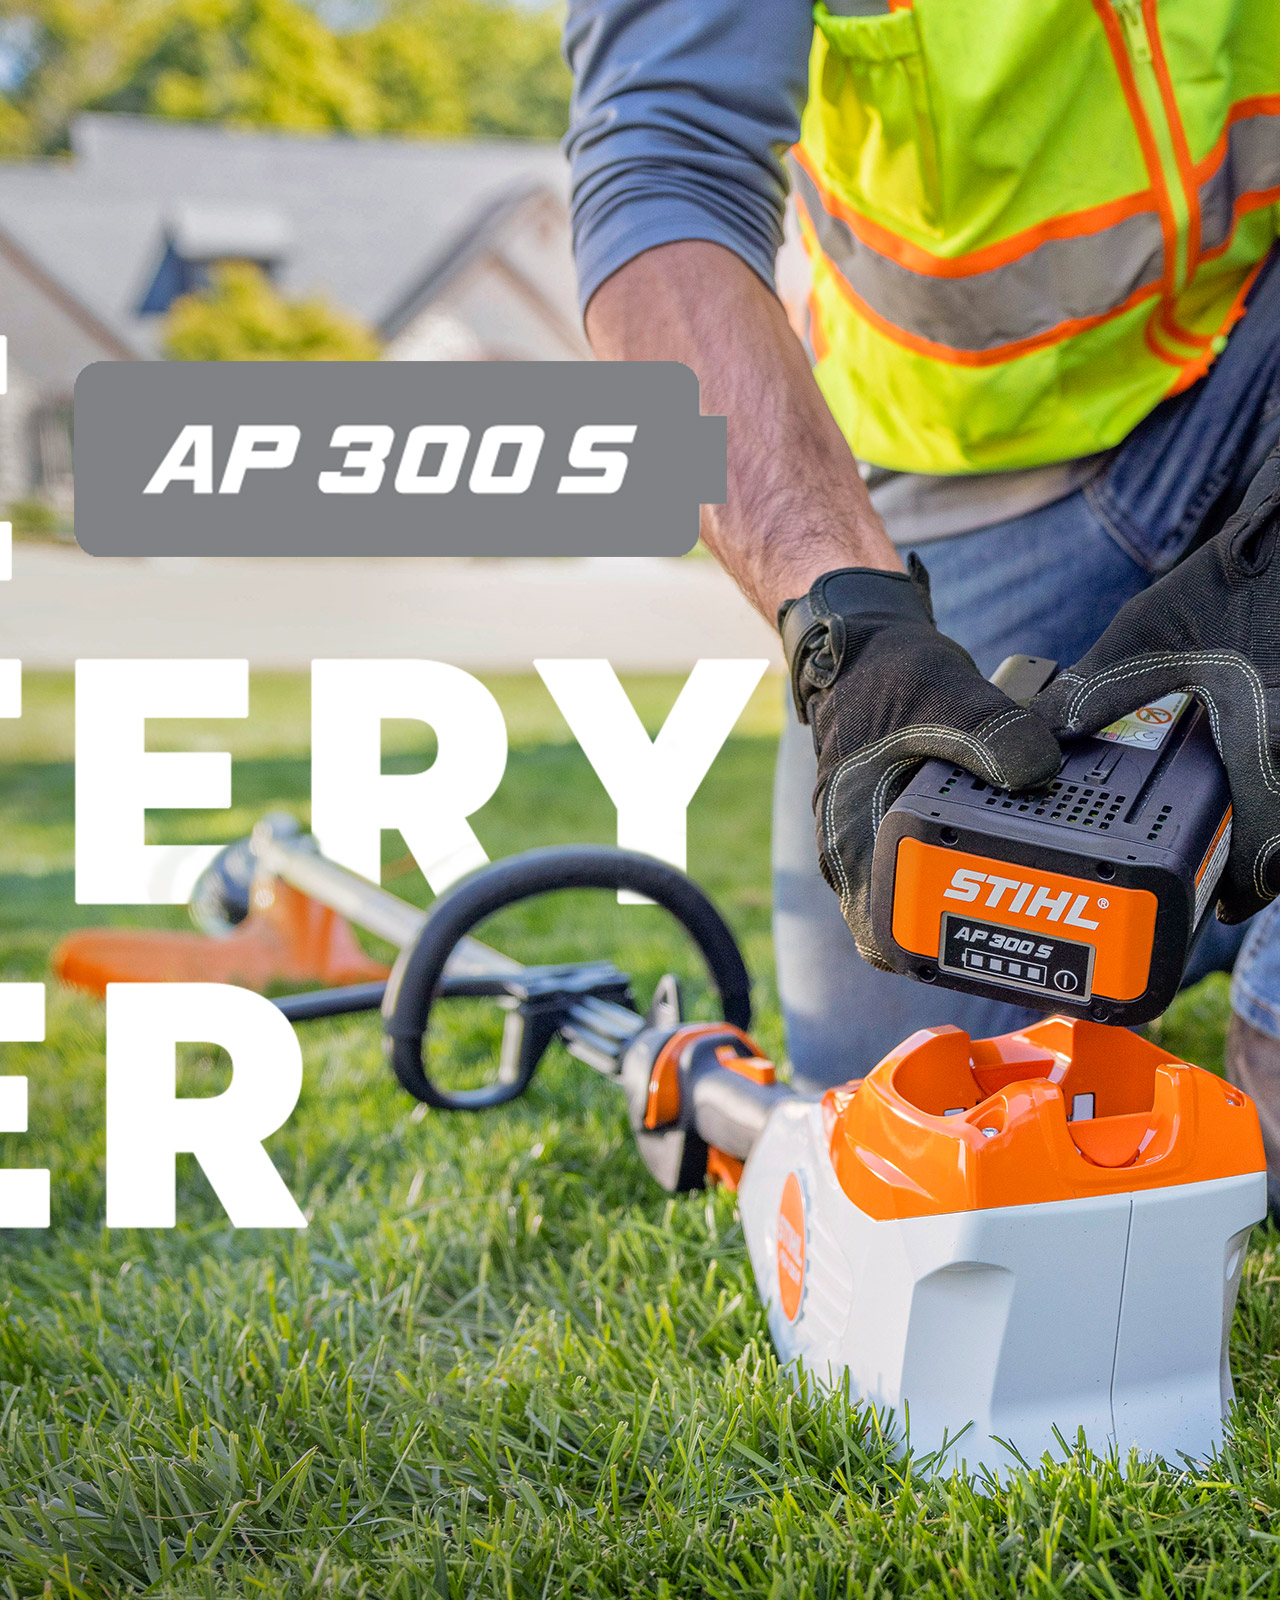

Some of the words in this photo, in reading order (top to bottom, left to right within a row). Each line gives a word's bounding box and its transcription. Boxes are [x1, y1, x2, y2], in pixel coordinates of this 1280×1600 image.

[954, 926, 988, 944] AP
[989, 933, 1036, 955] 300
[1034, 943, 1055, 960] S
